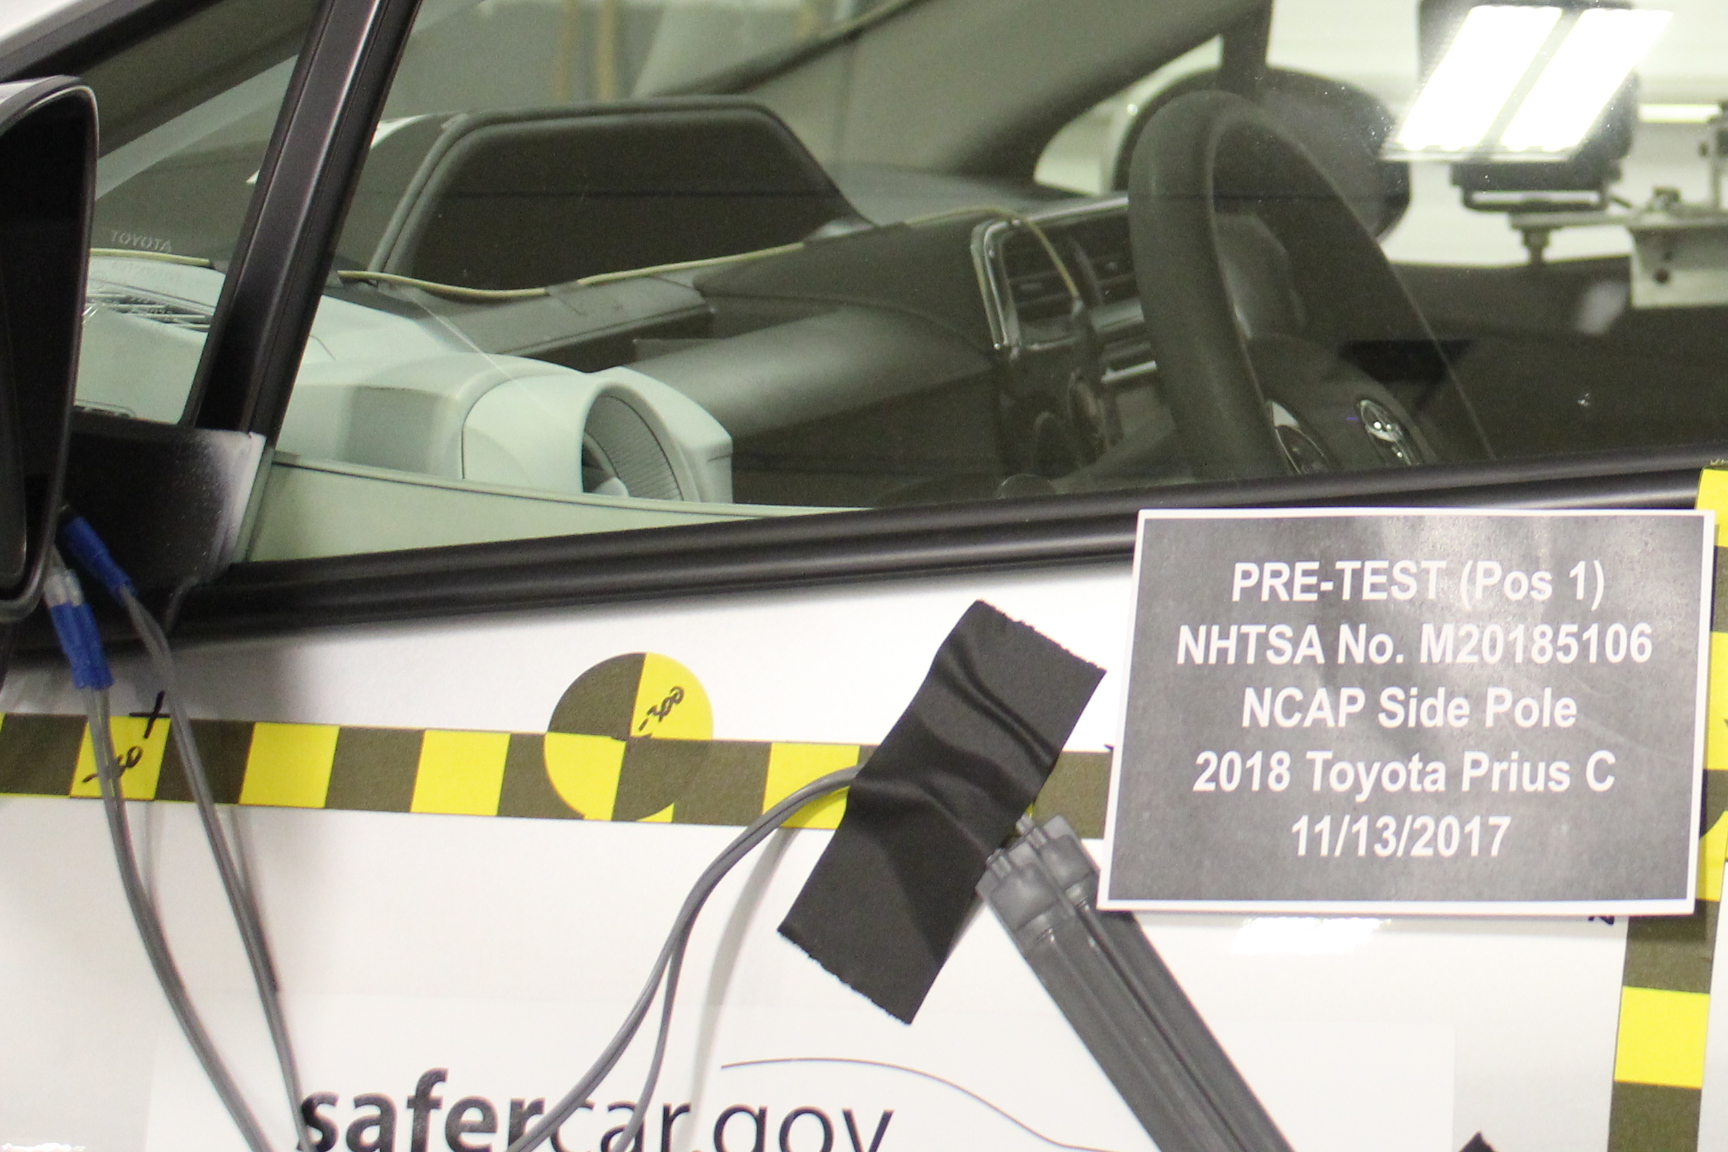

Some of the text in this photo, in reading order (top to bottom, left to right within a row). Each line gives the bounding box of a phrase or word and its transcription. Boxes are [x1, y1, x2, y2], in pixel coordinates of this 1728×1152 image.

[111, 230, 172, 253] TOYOTA
[1232, 559, 1605, 610] PRE-TEST (Pos 1)
[1177, 622, 1653, 665] NHTSA No. M20185106
[1242, 686, 1578, 728] NCAP Side Pole
[1193, 750, 1617, 803] 2018 Toyota Prius C
[1291, 815, 1511, 858] 11/13/2017
[296, 1067, 895, 1152] safercargov
